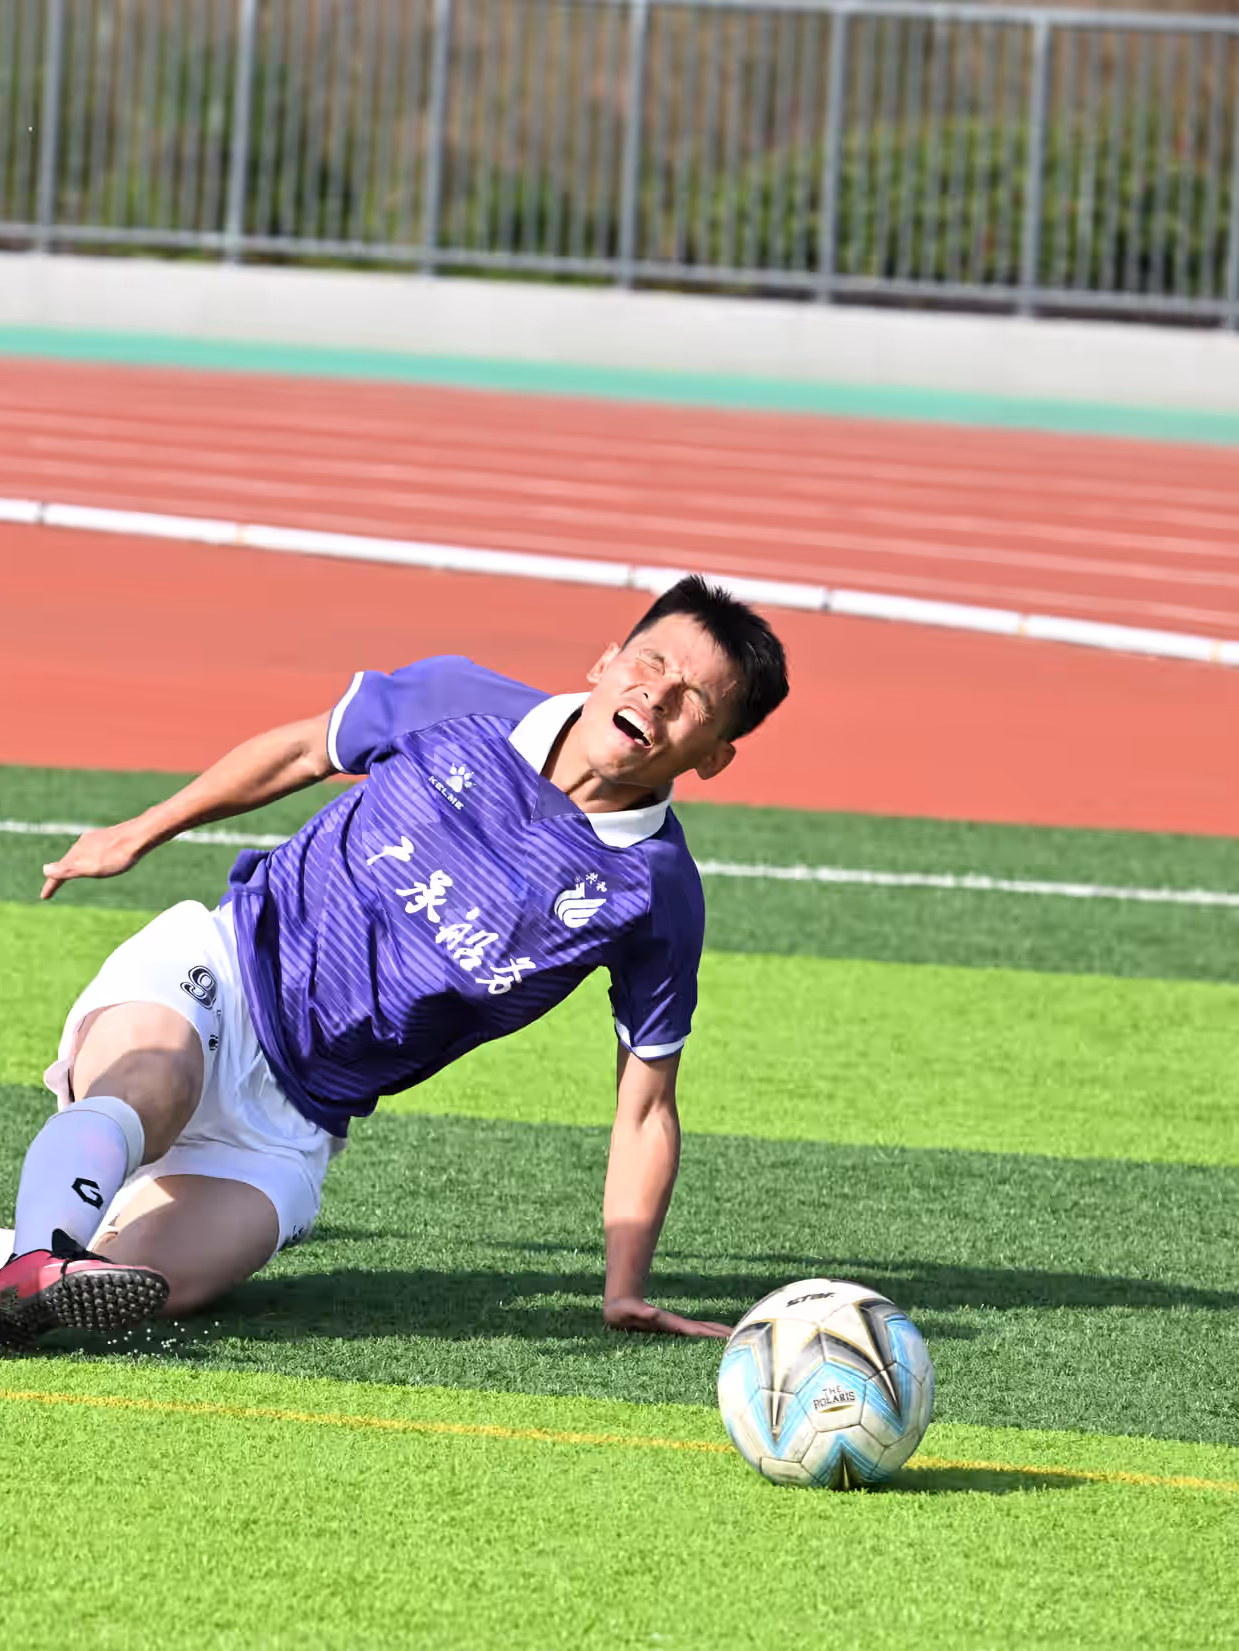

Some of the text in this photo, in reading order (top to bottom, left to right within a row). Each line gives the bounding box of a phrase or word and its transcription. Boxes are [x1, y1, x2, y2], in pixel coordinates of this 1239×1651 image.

[427, 775, 465, 810] KELME
[813, 1391, 855, 1409] POLARIS
[822, 1385, 841, 1397] THE
